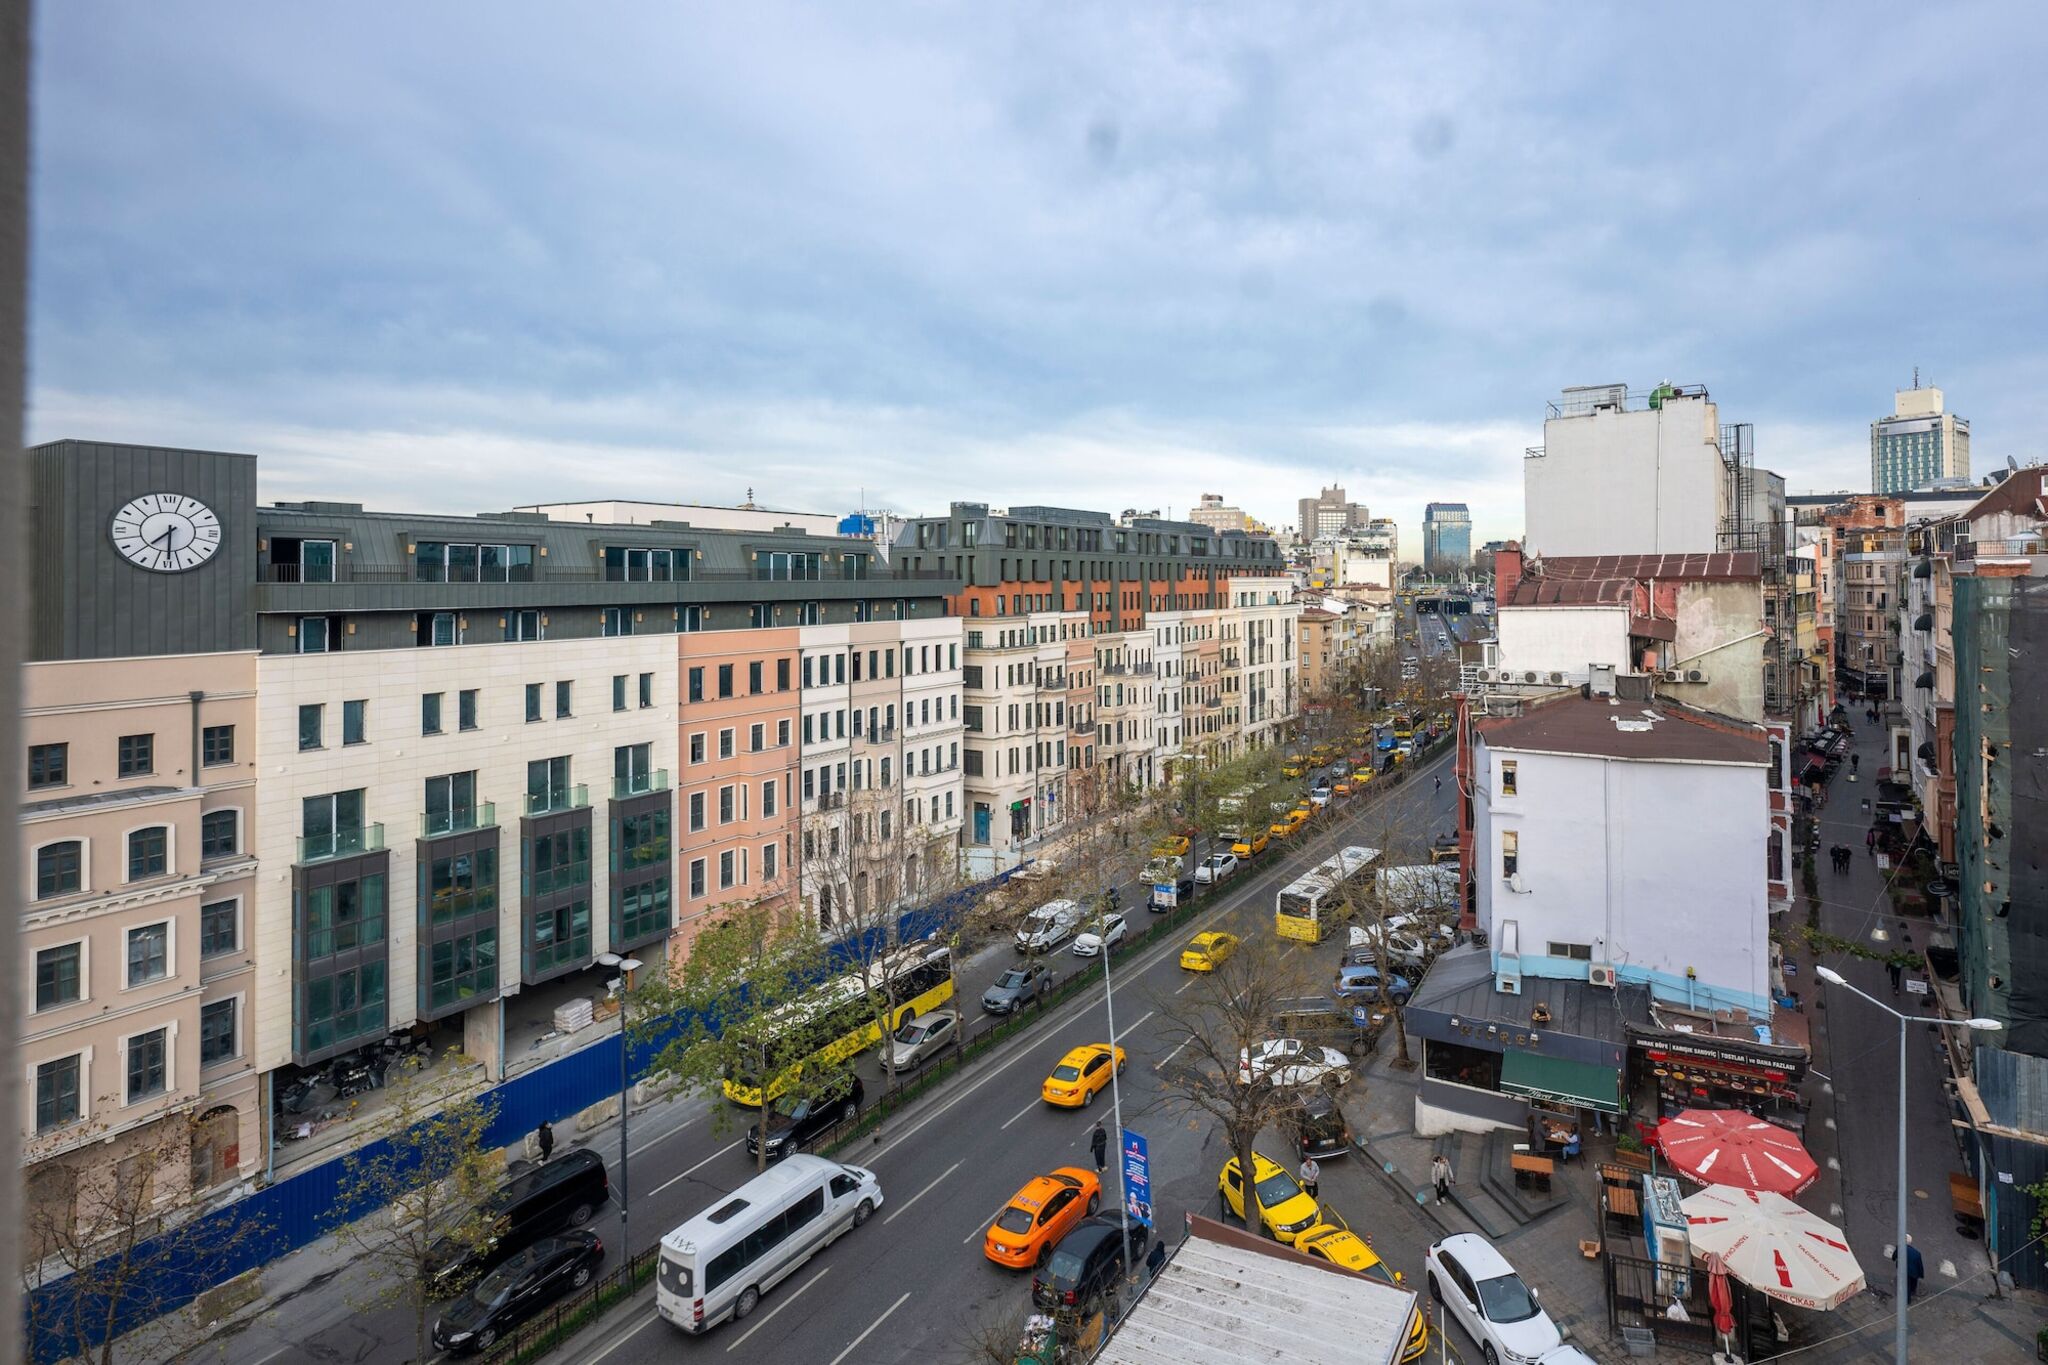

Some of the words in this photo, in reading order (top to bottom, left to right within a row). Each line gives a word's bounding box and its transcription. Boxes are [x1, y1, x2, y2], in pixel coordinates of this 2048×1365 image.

[163, 495, 177, 503] XII
[163, 561, 173, 569] VI
[1773, 1061, 1796, 1071] FAZLASI
[1789, 1296, 1816, 1308] ÇIKAR
